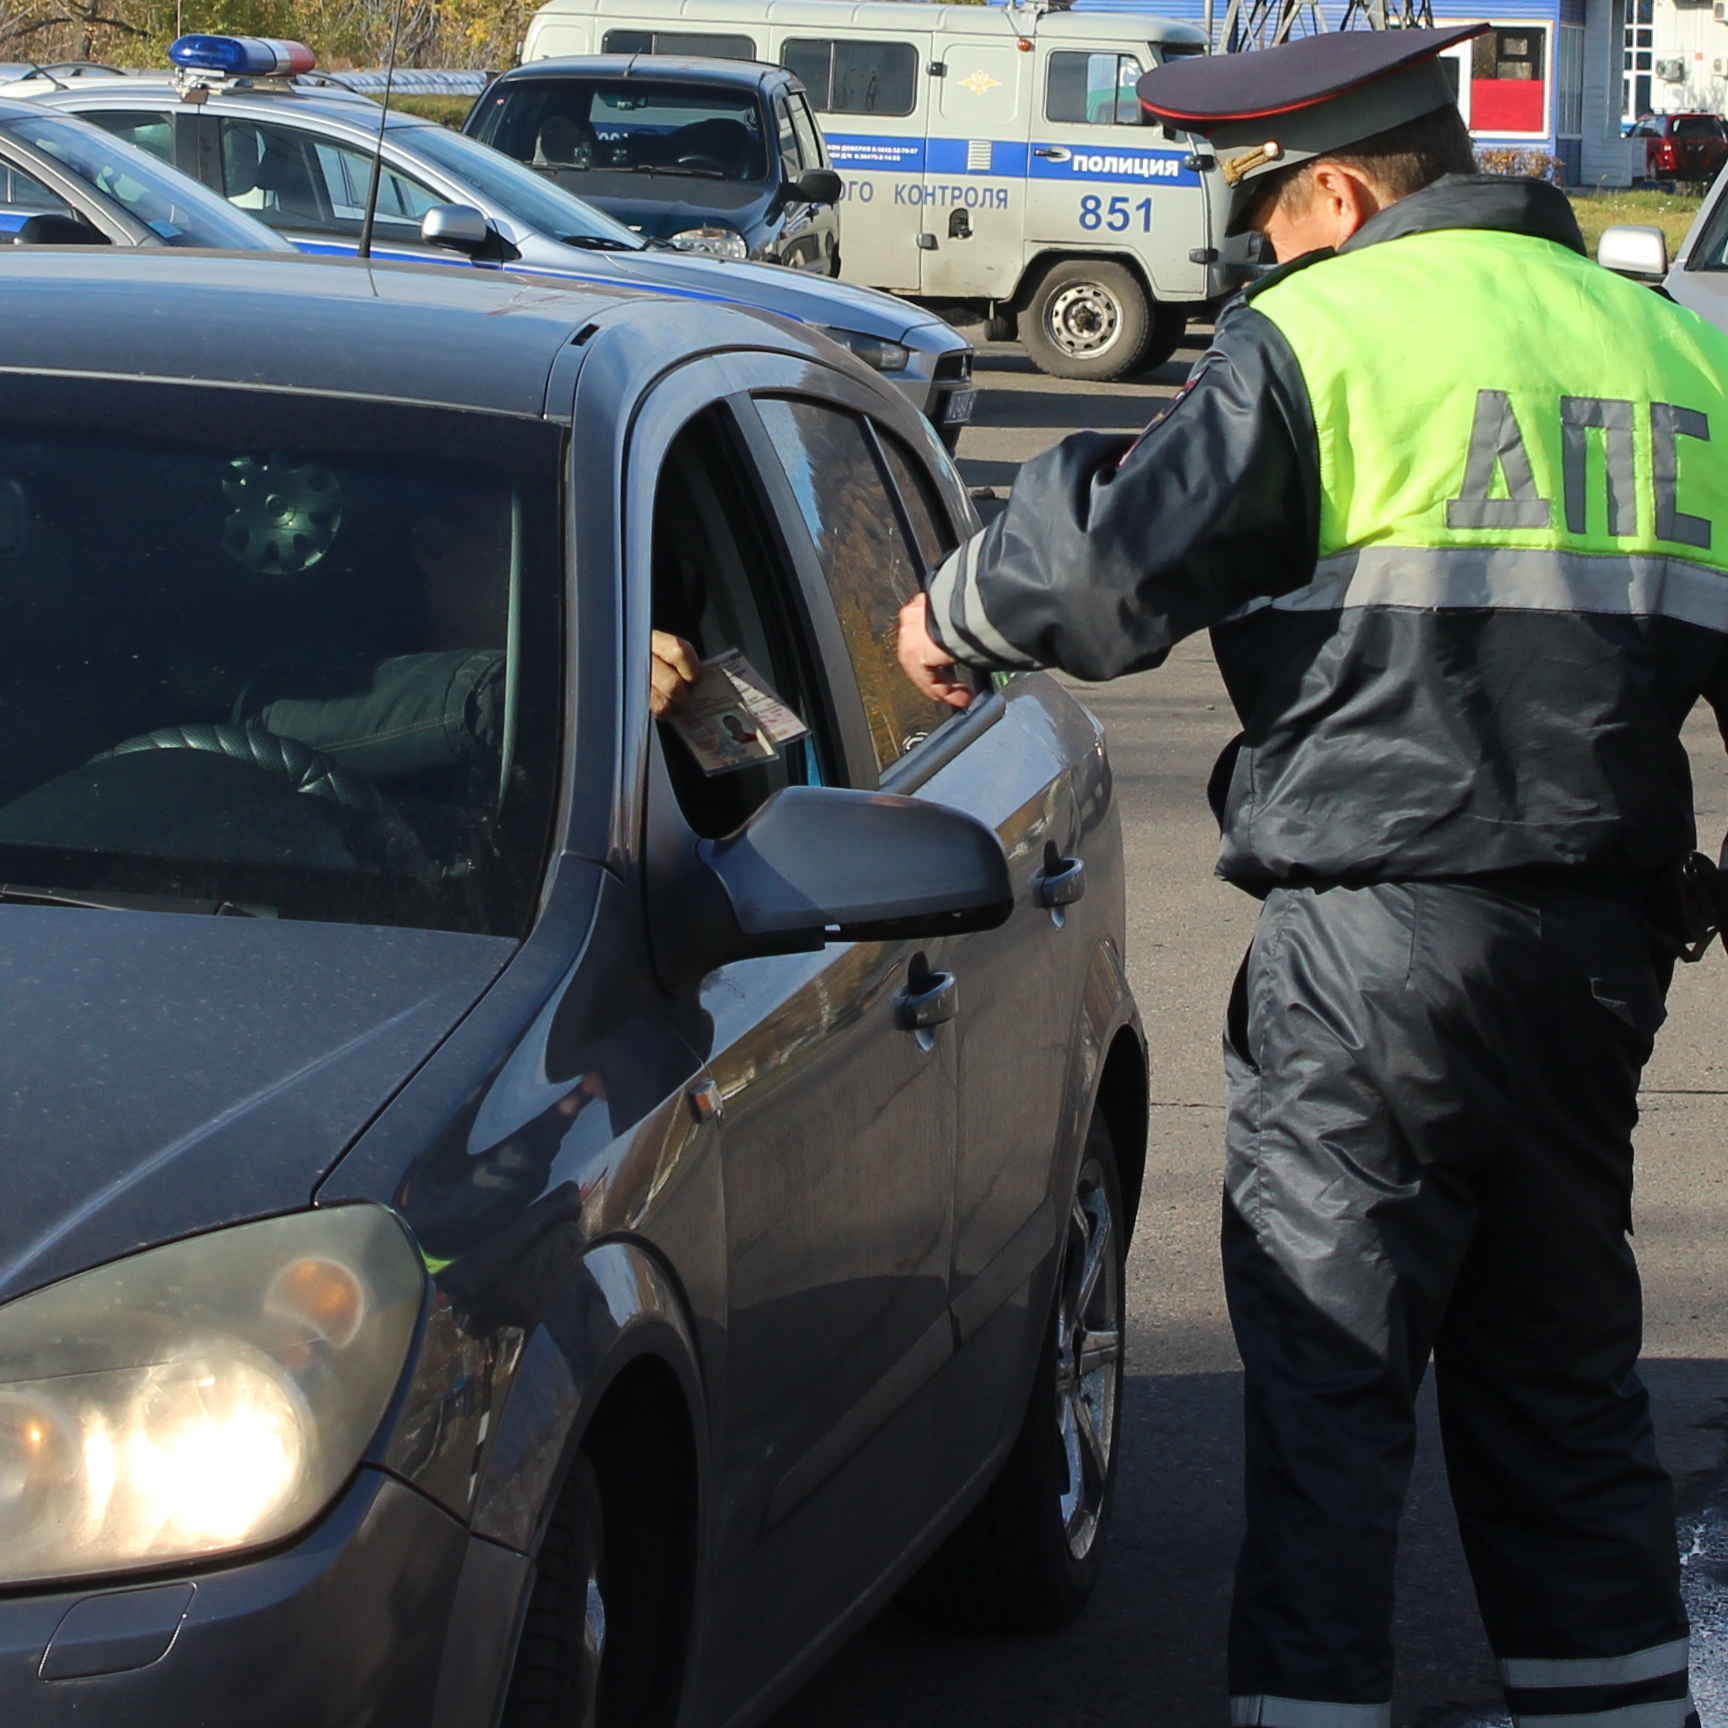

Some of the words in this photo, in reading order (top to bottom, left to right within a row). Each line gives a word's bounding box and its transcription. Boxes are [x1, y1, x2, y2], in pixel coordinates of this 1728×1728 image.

[1073, 155, 1180, 177] ПОЛИЦИЯ
[894, 183, 1009, 210] КОНТРОЛЯ
[1079, 194, 1153, 233] 851
[1446, 388, 1712, 549] ДПС
